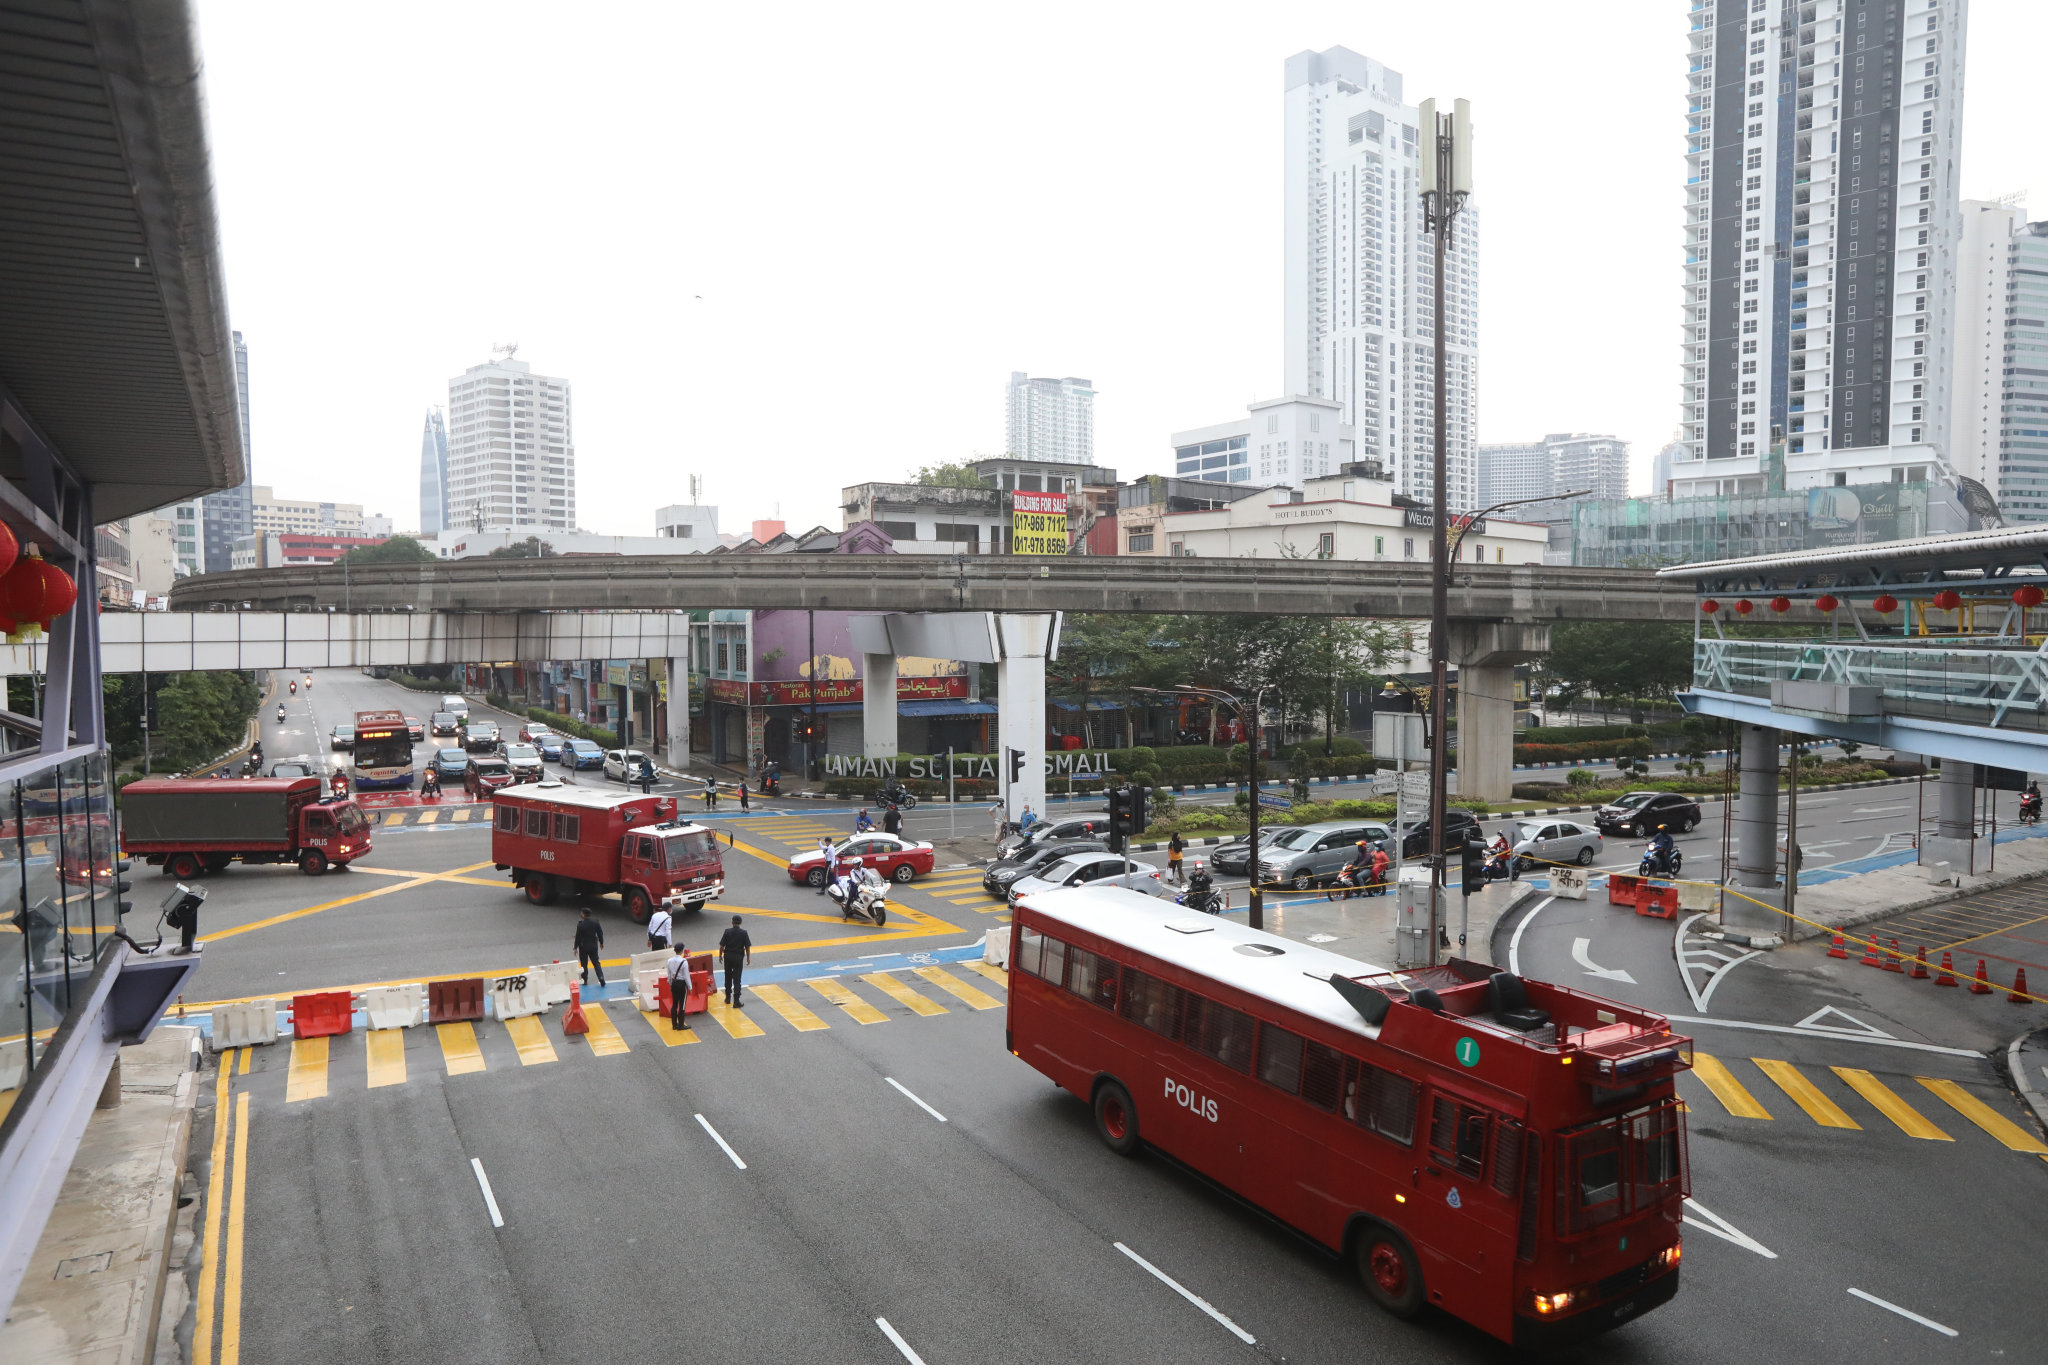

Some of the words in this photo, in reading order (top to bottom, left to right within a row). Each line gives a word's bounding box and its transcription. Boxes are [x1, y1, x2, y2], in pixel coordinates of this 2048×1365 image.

[1014, 495, 1040, 511] BUILDING
[1041, 496, 1052, 512] FOR
[1053, 498, 1067, 513] SALE
[1863, 503, 1895, 514] Quill
[1015, 514, 1044, 531] 017-968
[1047, 516, 1066, 533] 7112
[1408, 511, 1434, 526] WELCO
[1015, 536, 1044, 553] 017-978
[1047, 537, 1066, 554] 8569
[791, 689, 811, 699] Pak
[814, 686, 850, 700] Punjab
[909, 757, 996, 778] SUTA
[1044, 752, 1117, 775] SMAIL
[309, 838, 328, 846] POLIS
[540, 850, 555, 861] POLIS
[1461, 1041, 1472, 1063] 1
[1164, 1077, 1219, 1123] POLIS
